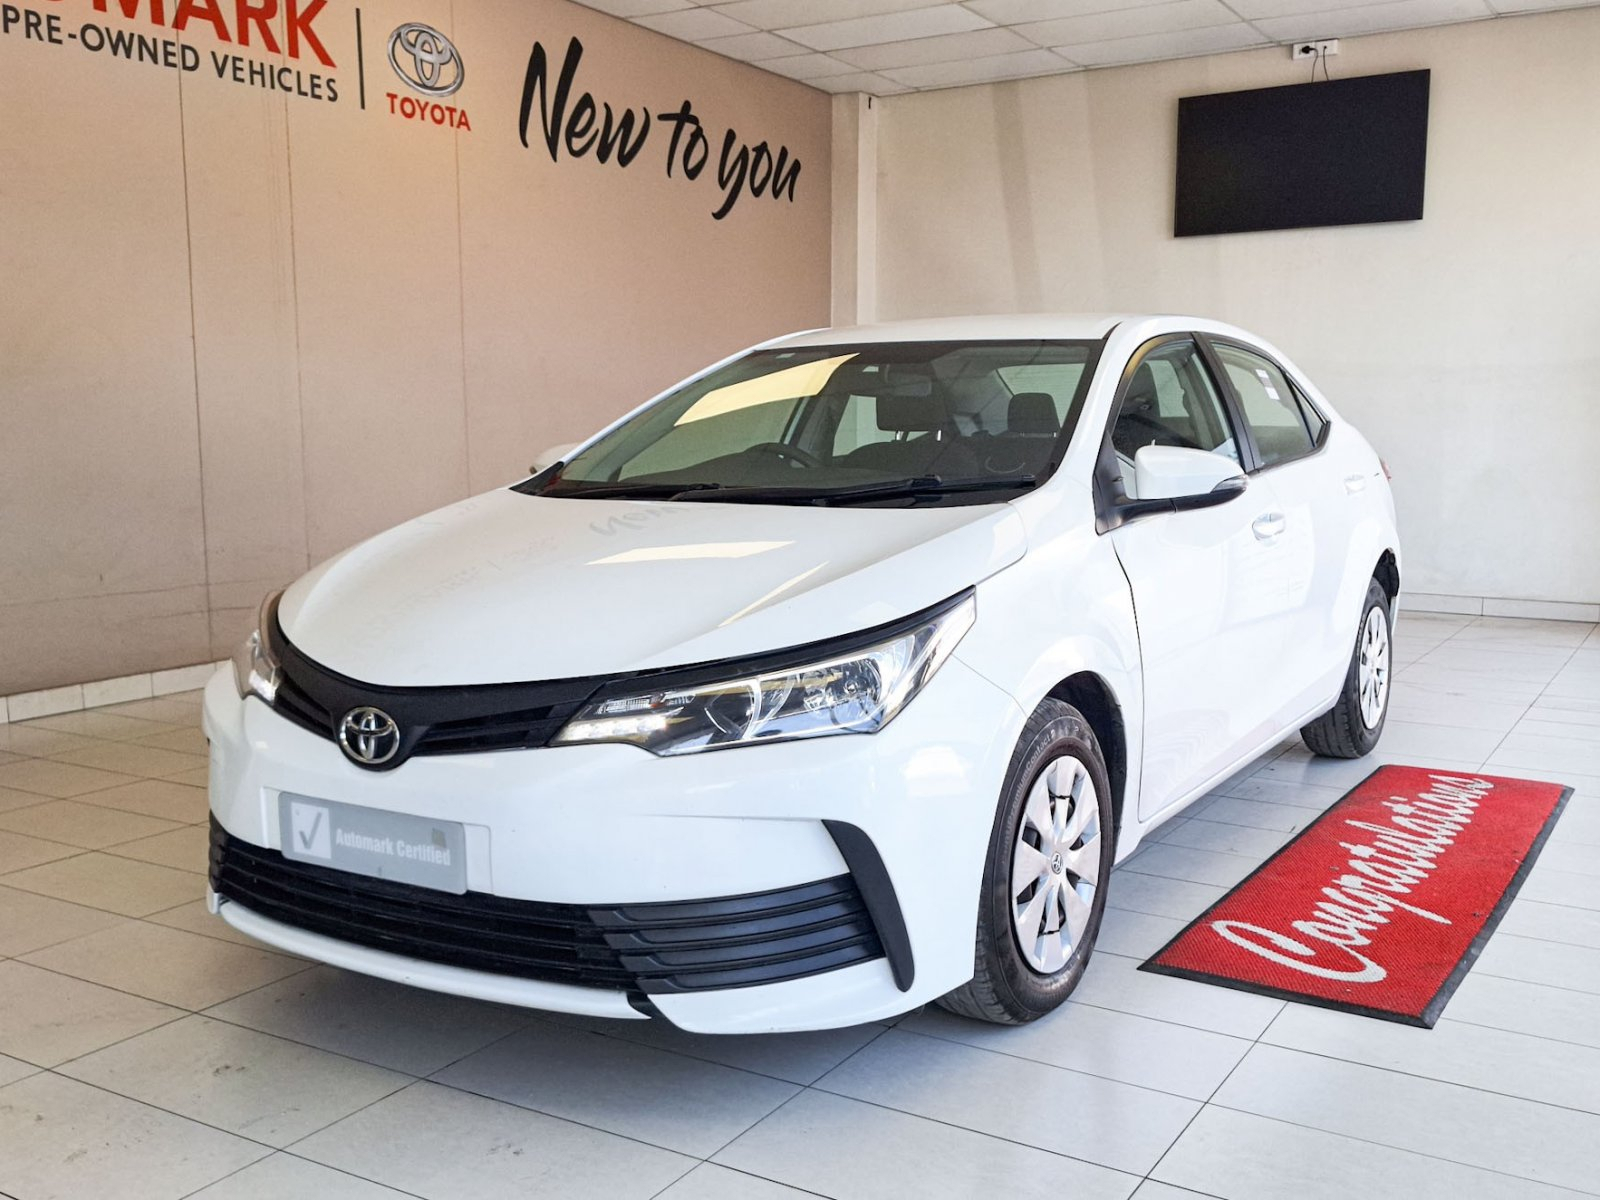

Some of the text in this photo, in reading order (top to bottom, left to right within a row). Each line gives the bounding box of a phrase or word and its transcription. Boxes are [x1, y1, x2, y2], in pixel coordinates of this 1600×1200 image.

[2, 4, 338, 102] PRE-OWNED VEHICLES
[44, 0, 337, 68] ARK
[386, 92, 472, 131] TOYOTA
[519, 36, 801, 220] New to you
[335, 828, 452, 867] Automark Certified
[1210, 773, 1495, 984] Congratulations
